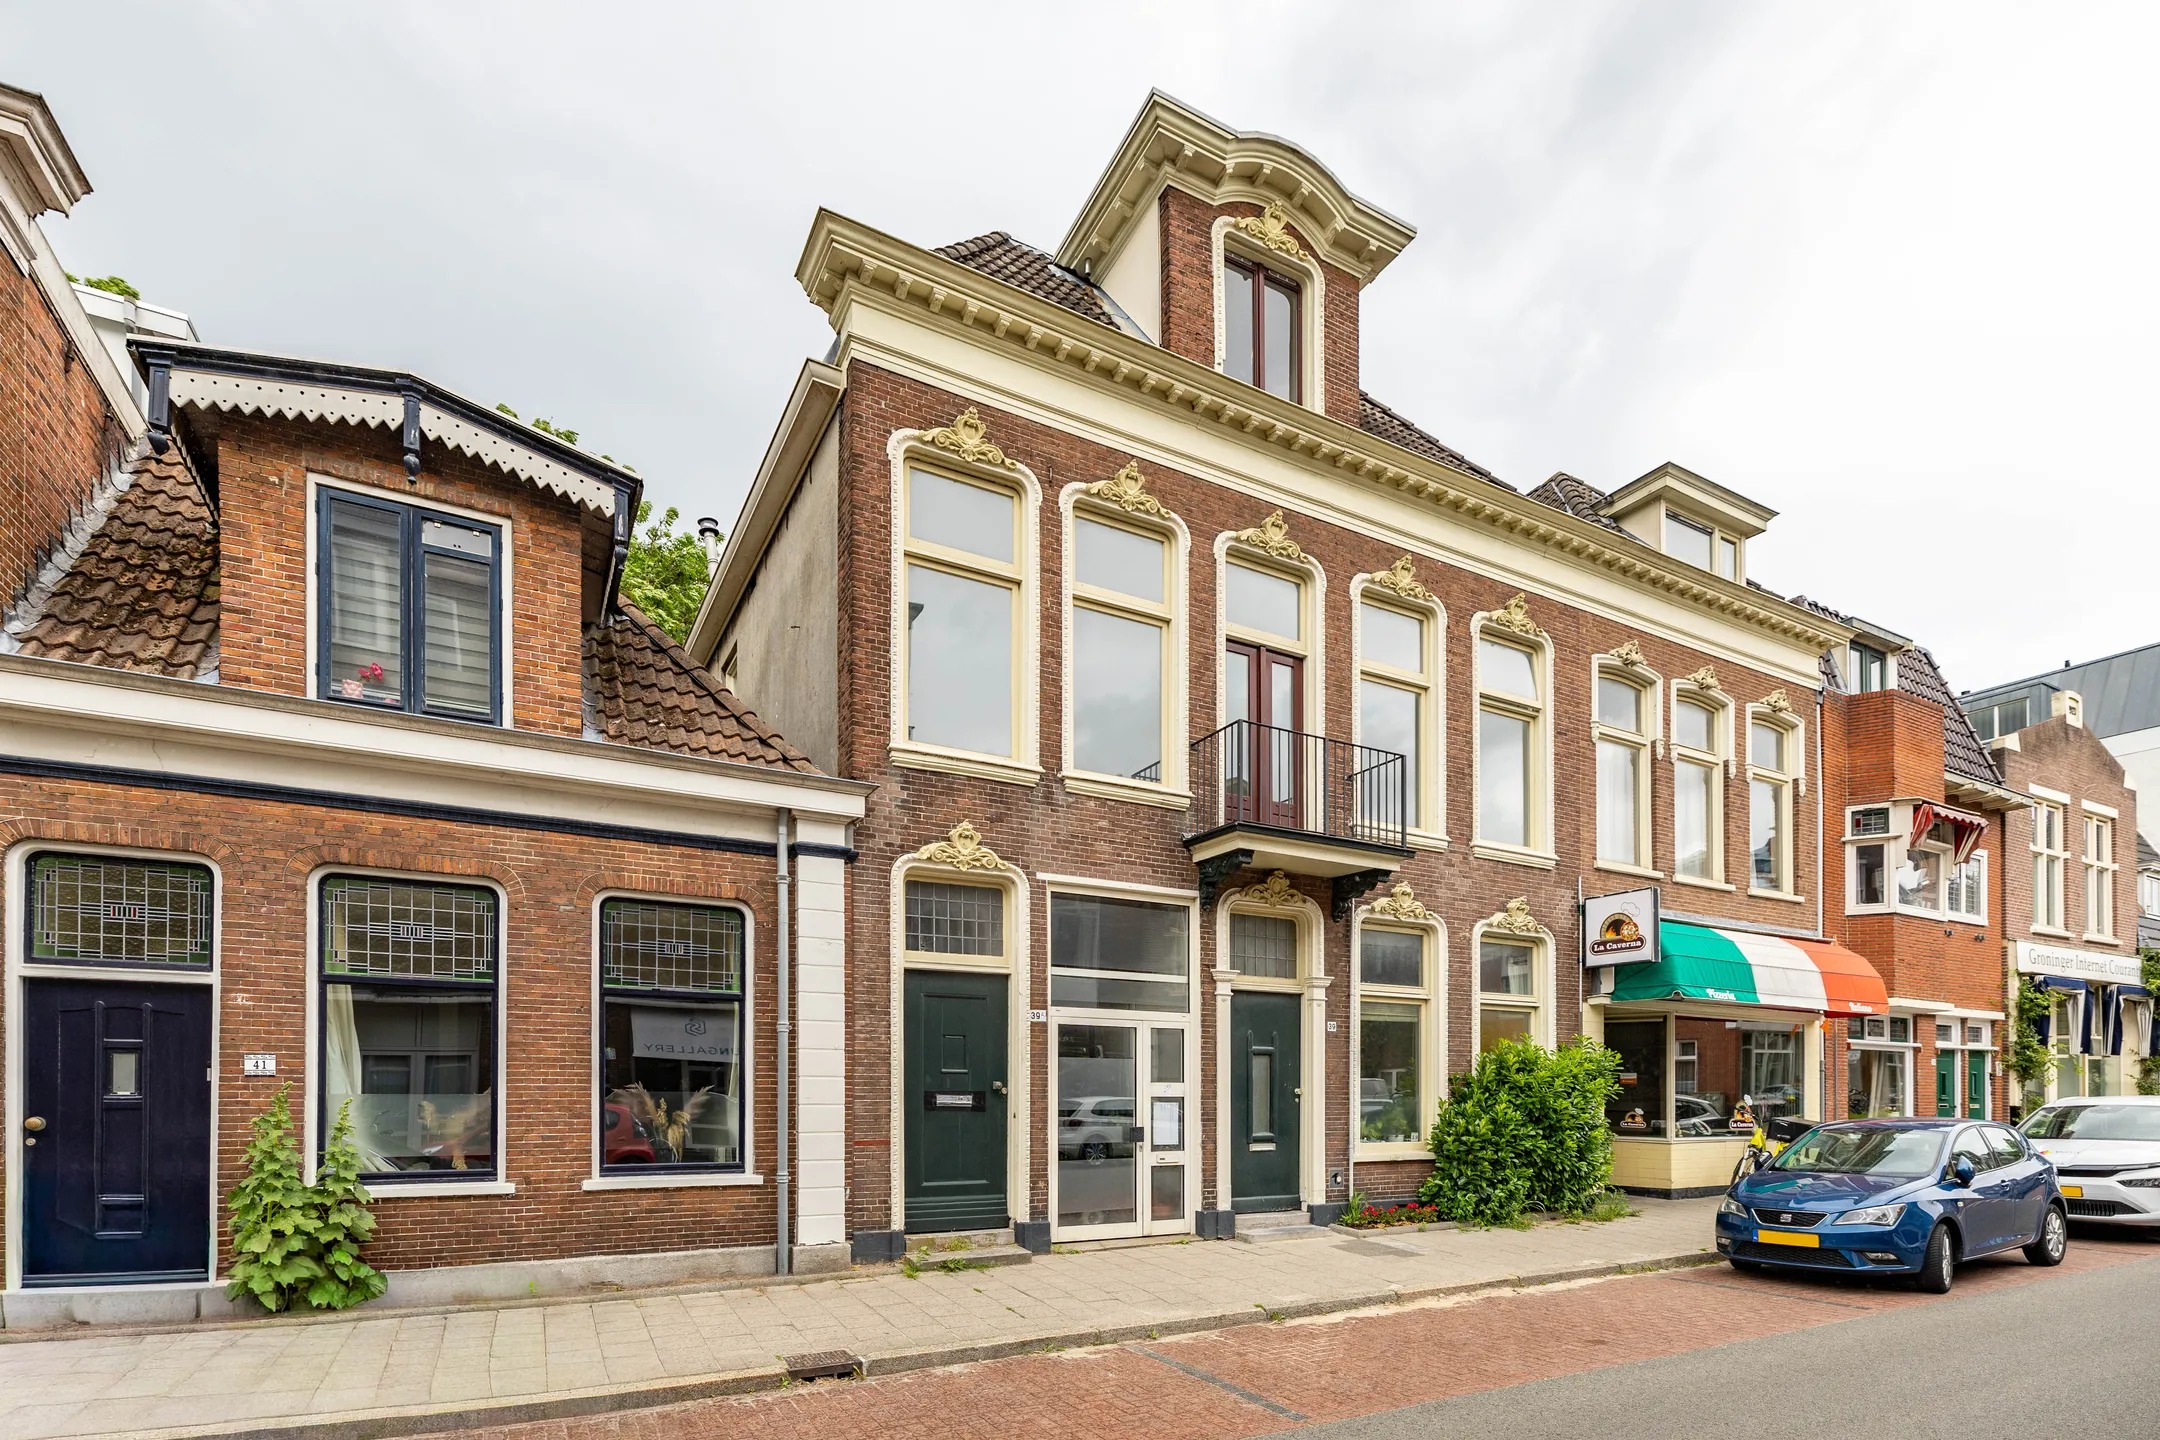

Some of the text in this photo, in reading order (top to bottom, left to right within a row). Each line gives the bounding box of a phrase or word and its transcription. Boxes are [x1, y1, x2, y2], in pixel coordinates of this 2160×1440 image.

[1606, 940, 1642, 950] Caverna
[2029, 948, 2073, 973] Groninger
[2075, 954, 2108, 973] Internet
[252, 1060, 267, 1070] 41
